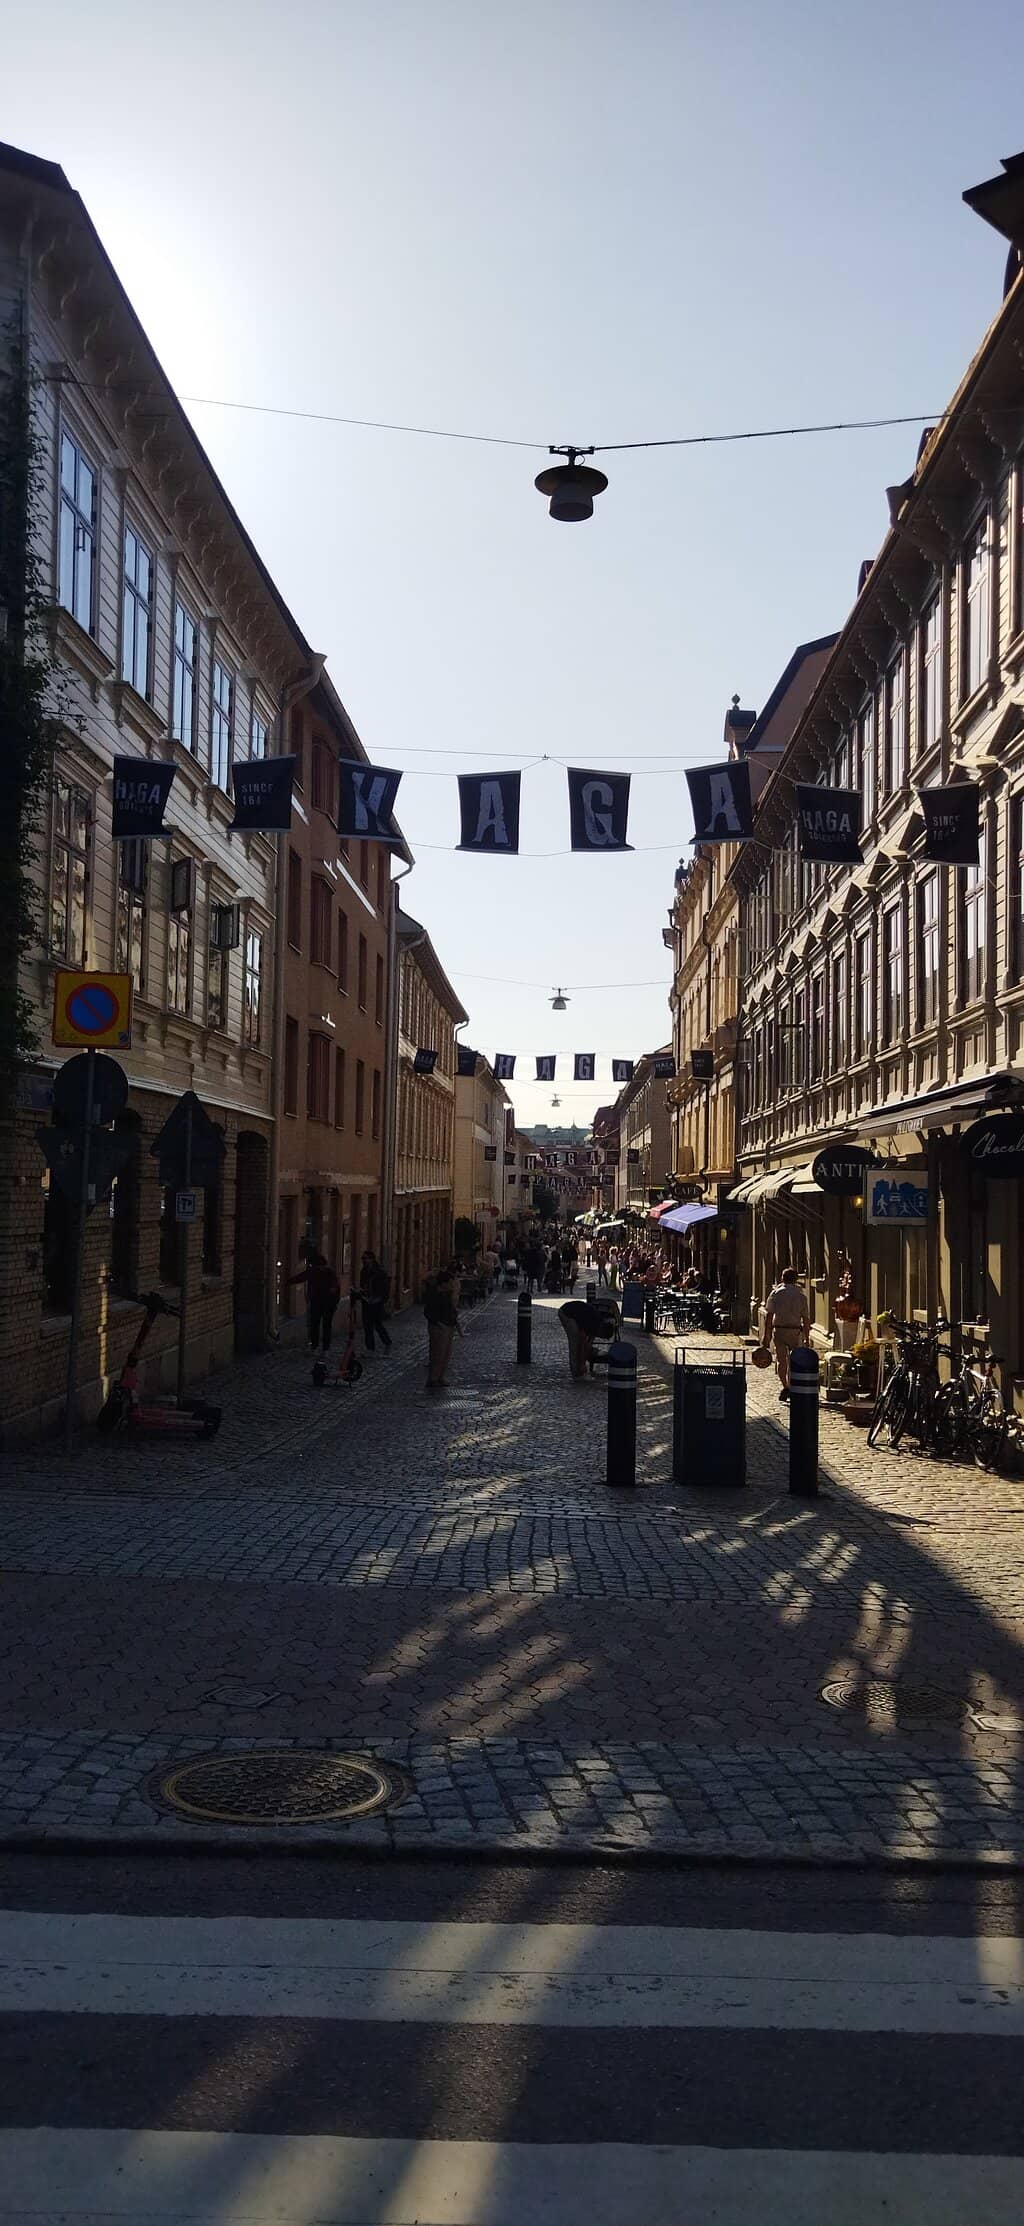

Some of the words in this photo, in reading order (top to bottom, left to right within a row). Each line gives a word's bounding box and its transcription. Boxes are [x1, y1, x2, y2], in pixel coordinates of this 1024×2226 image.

[472, 780, 510, 845] A
[581, 780, 619, 845] G
[705, 773, 745, 833] A
[802, 808, 851, 833] HAGA
[971, 1131, 1024, 1159] Chocol
[816, 1162, 875, 1177] ANTI
